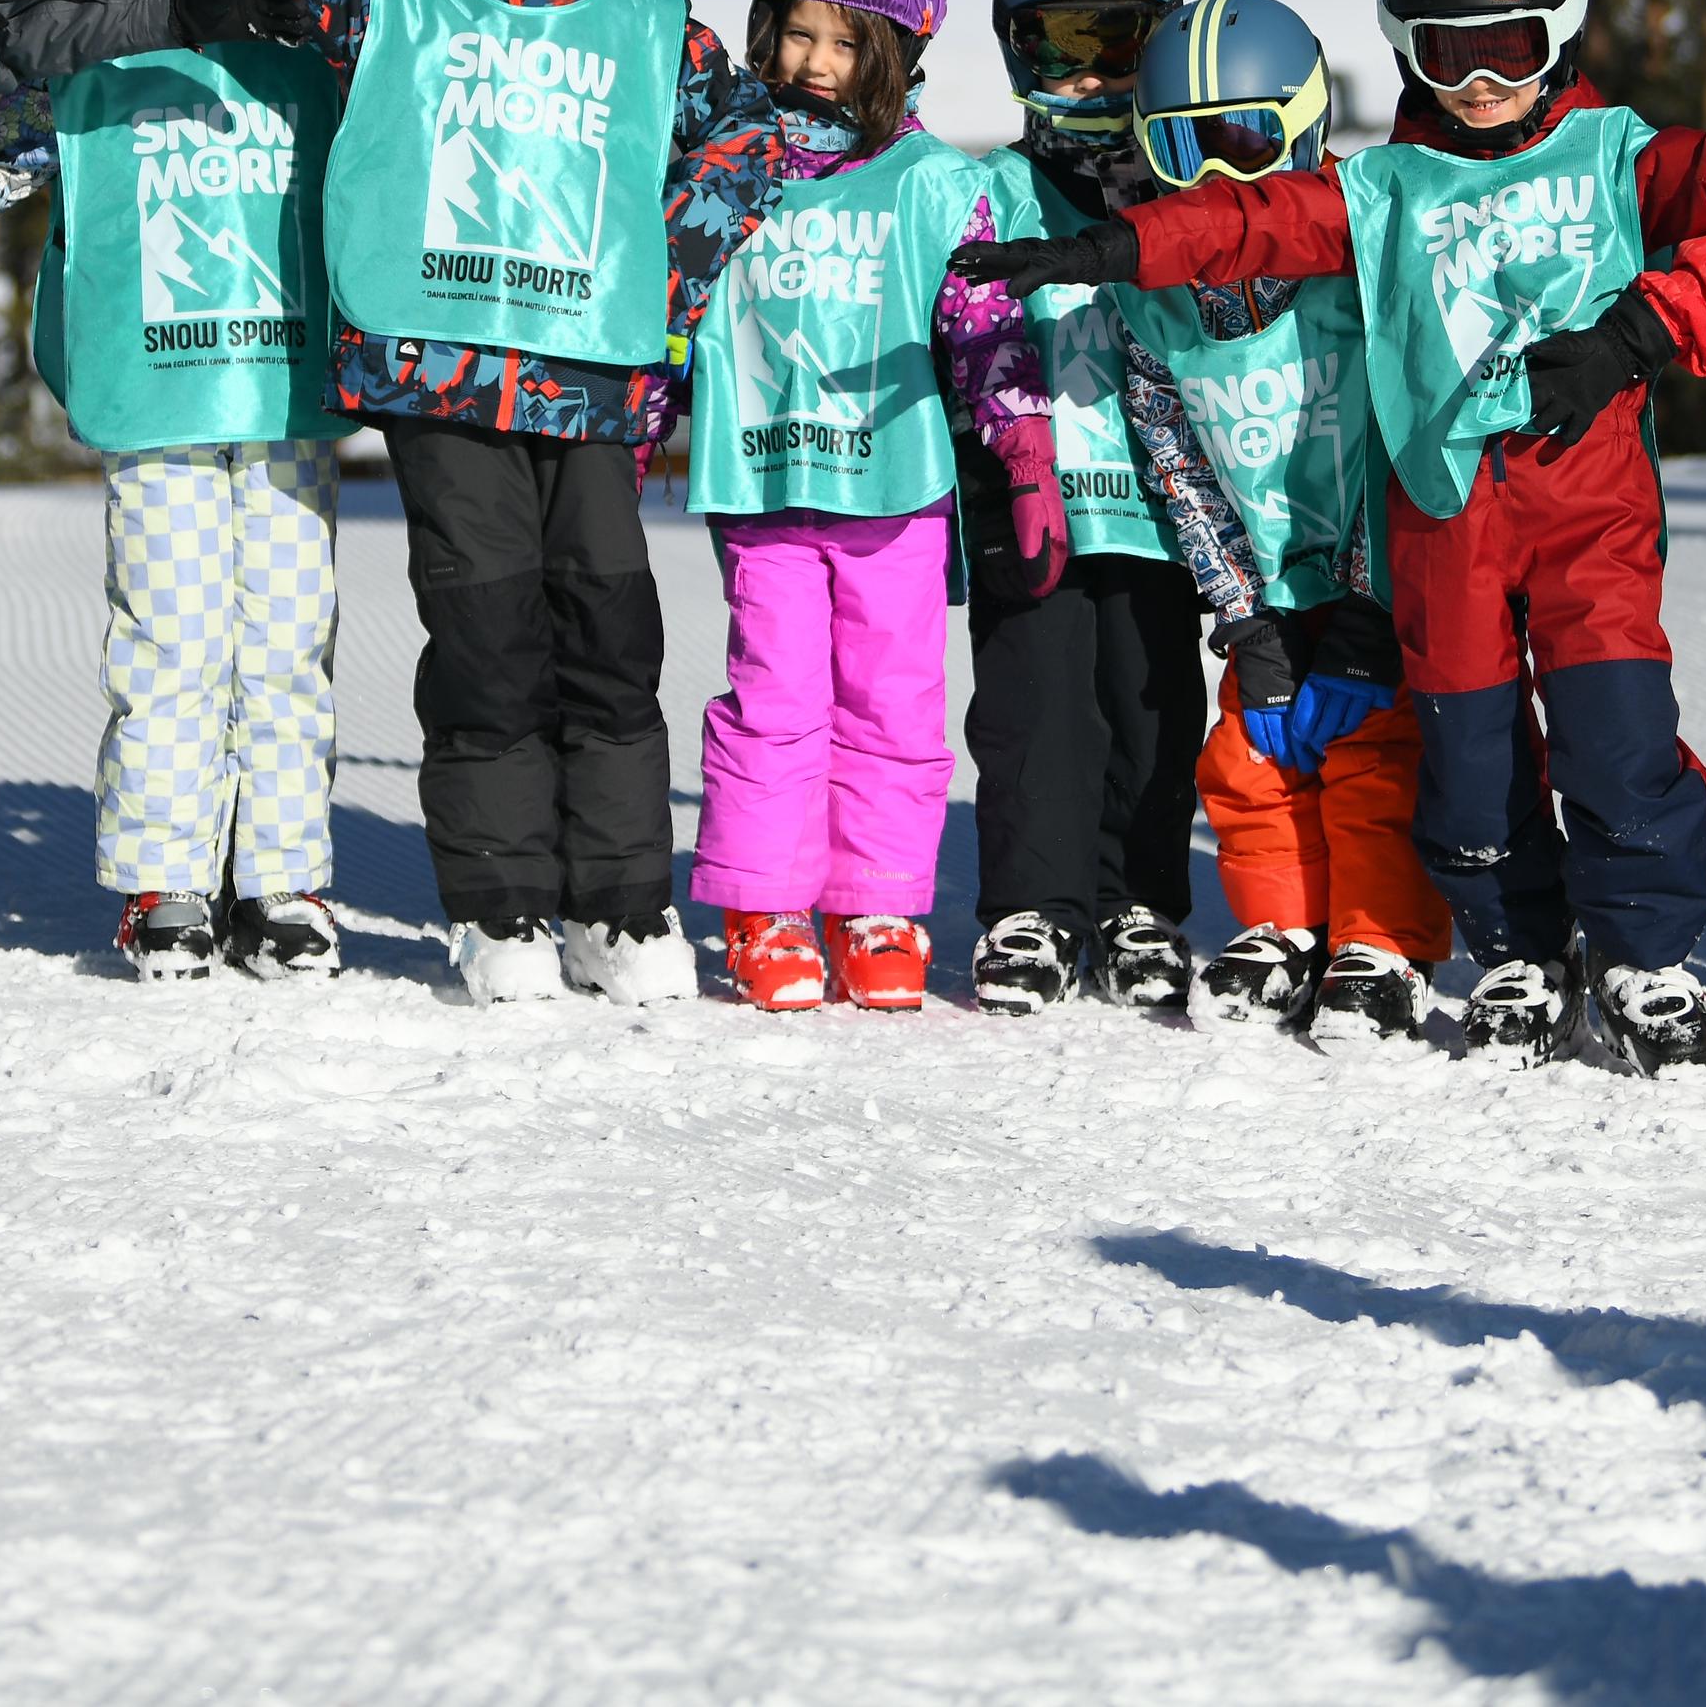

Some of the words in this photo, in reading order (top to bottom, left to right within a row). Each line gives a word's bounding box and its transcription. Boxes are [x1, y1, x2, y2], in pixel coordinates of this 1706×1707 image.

[444, 32, 616, 100] SNOW
[132, 100, 298, 156] SNOW
[439, 83, 612, 147] MORE
[138, 146, 299, 201] MORE
[731, 208, 893, 257] NOW
[1421, 175, 1594, 254] SNOW
[421, 252, 494, 284] SNOW
[503, 259, 592, 300] SPORTS
[728, 250, 885, 304] MORE
[1431, 223, 1594, 296] MORE
[427, 291, 446, 299] DAHA
[506, 297, 523, 307] DAHA
[524, 301, 546, 312] MUTLU
[547, 305, 582, 317] ÇOCUKLAR
[144, 321, 218, 353] SNOW
[227, 319, 306, 348] SPORTS
[153, 360, 172, 370] DAHA
[235, 356, 254, 365] DAHA
[1180, 352, 1338, 423] SNOW
[787, 422, 872, 458] SPORTS
[1197, 394, 1340, 470] MORE
[1060, 472, 1130, 500] SNOW
[1071, 508, 1088, 516] DAHA
[1346, 667, 1370, 677] WEDZE
[1267, 695, 1292, 705] WEDZE
